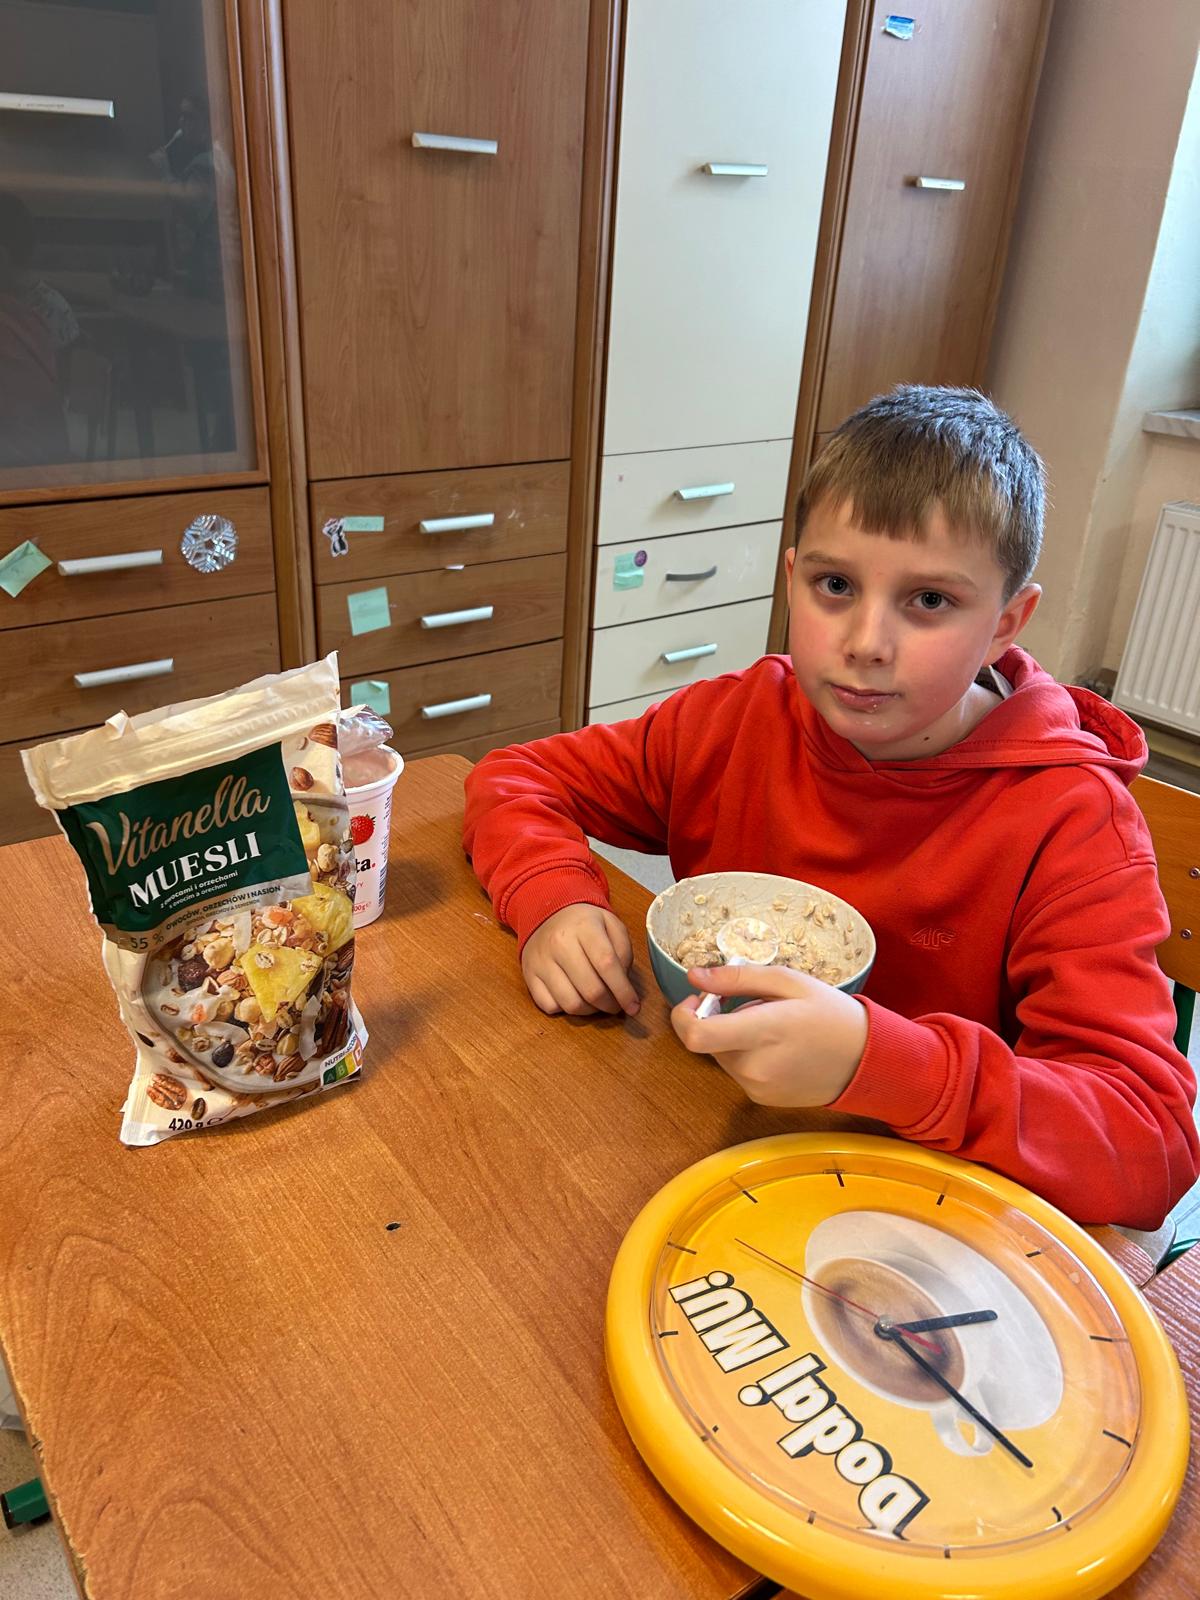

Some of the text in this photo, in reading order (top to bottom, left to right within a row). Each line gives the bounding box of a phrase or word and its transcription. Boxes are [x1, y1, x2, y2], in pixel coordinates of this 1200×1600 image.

[86, 775, 270, 875] Vitanella
[128, 832, 262, 908] MUESLI
[164, 885, 193, 905] owocami
[198, 870, 238, 888] orzechami
[200, 882, 228, 895] orechmi
[202, 894, 246, 912] ORZECHÓW
[250, 885, 281, 897] NASION
[168, 1118, 193, 1131] 420
[668, 1270, 790, 1373] MU!
